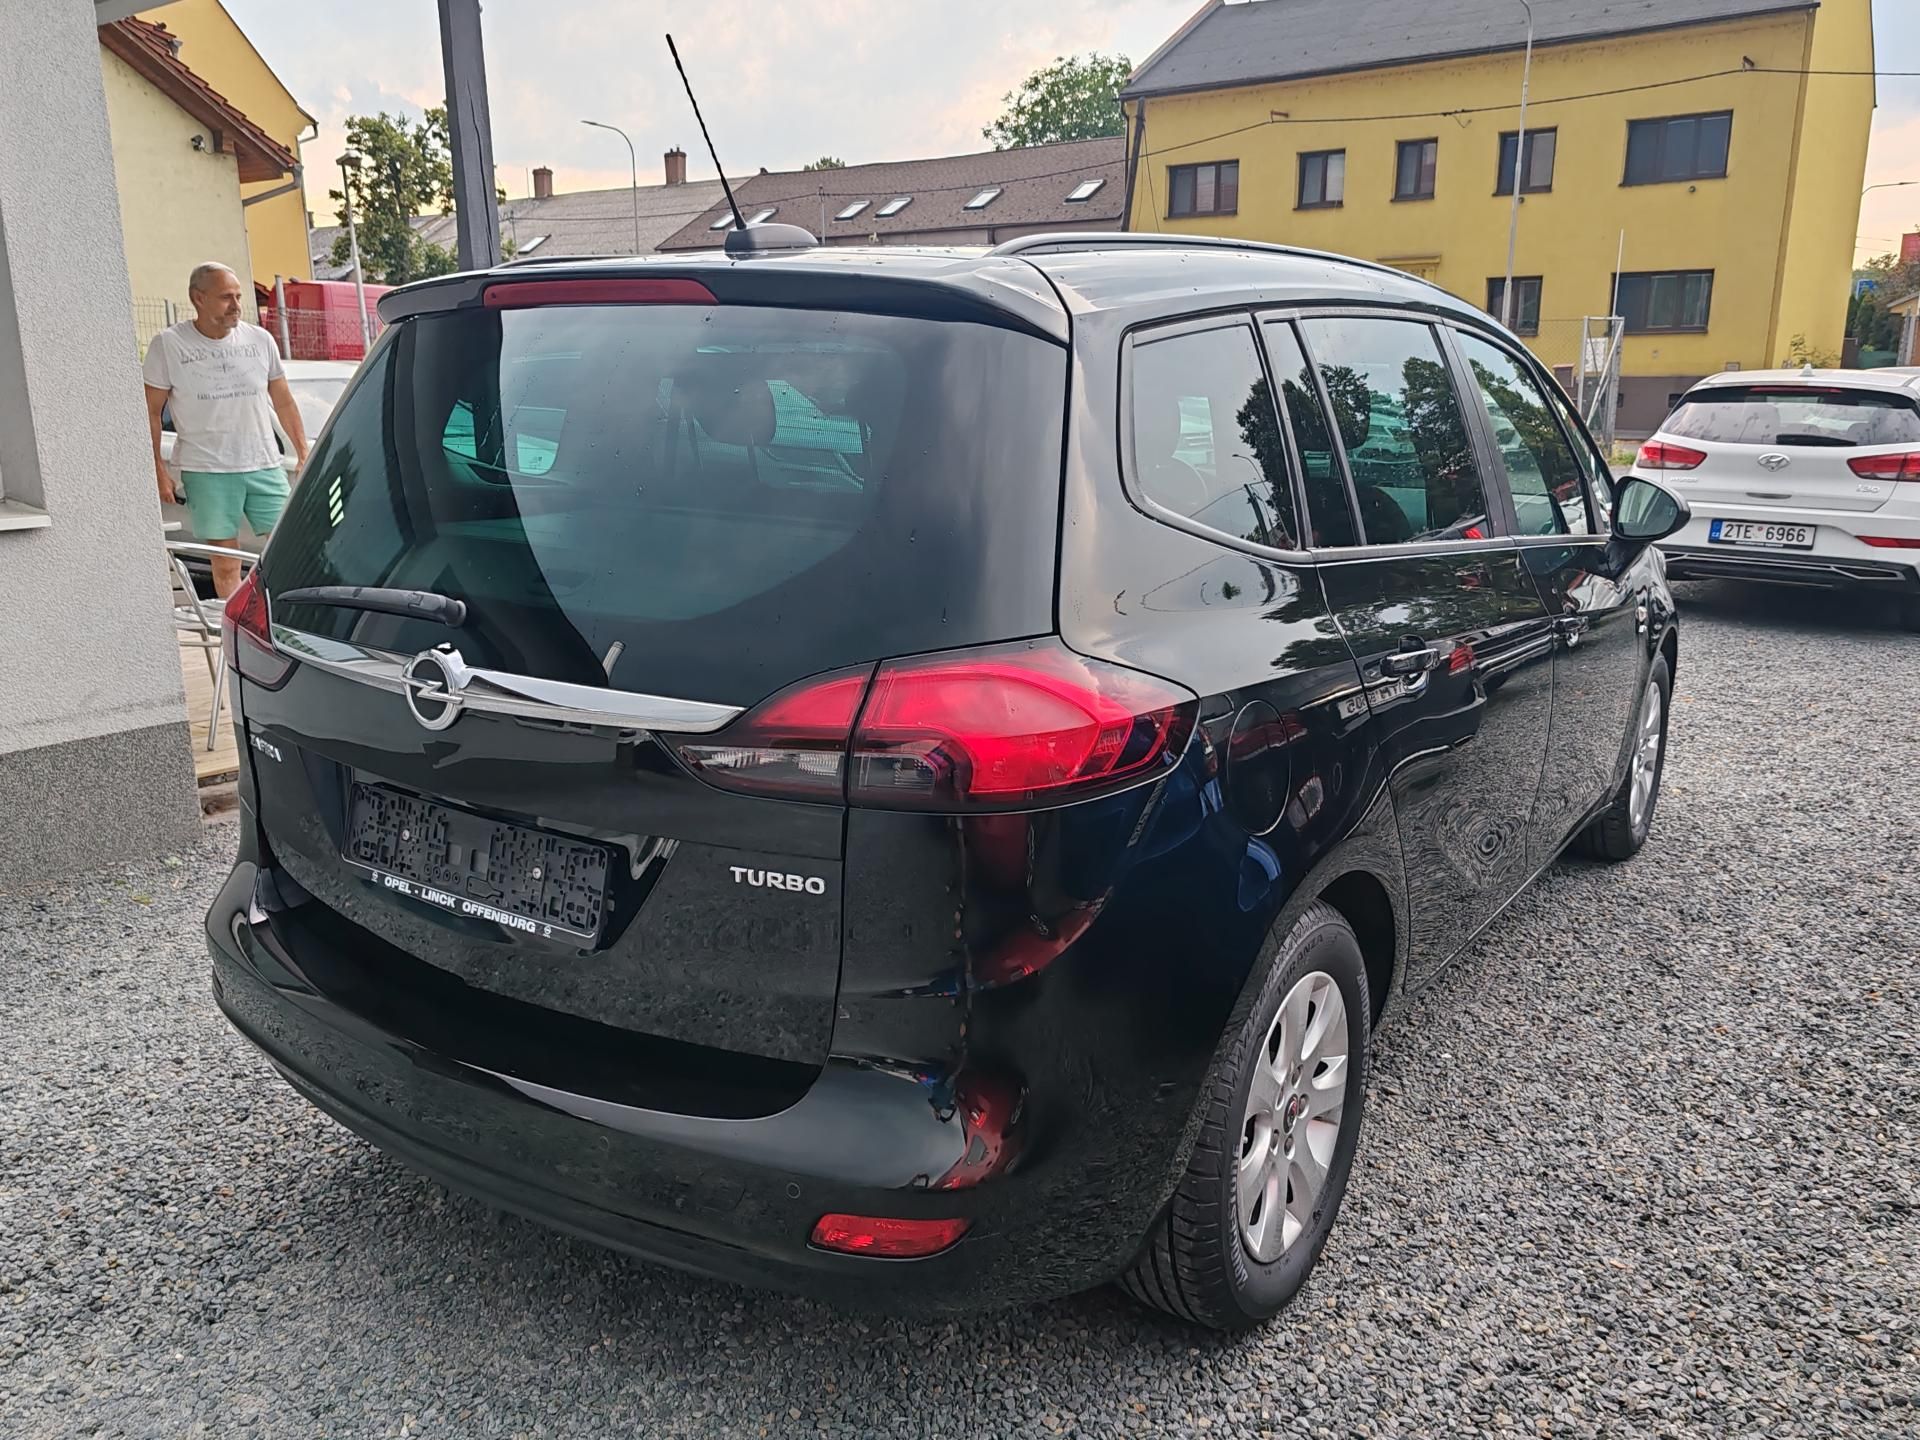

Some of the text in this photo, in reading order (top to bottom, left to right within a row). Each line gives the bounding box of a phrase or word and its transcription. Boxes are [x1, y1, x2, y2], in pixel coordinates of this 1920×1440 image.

[211, 343, 261, 360] COOPER
[1724, 523, 1754, 539] 2TE
[1765, 526, 1807, 543] 6966
[729, 865, 826, 895] TURBO
[384, 876, 412, 894] OPEL
[421, 887, 456, 908] LINCK
[462, 902, 536, 933] OFFENBURG
